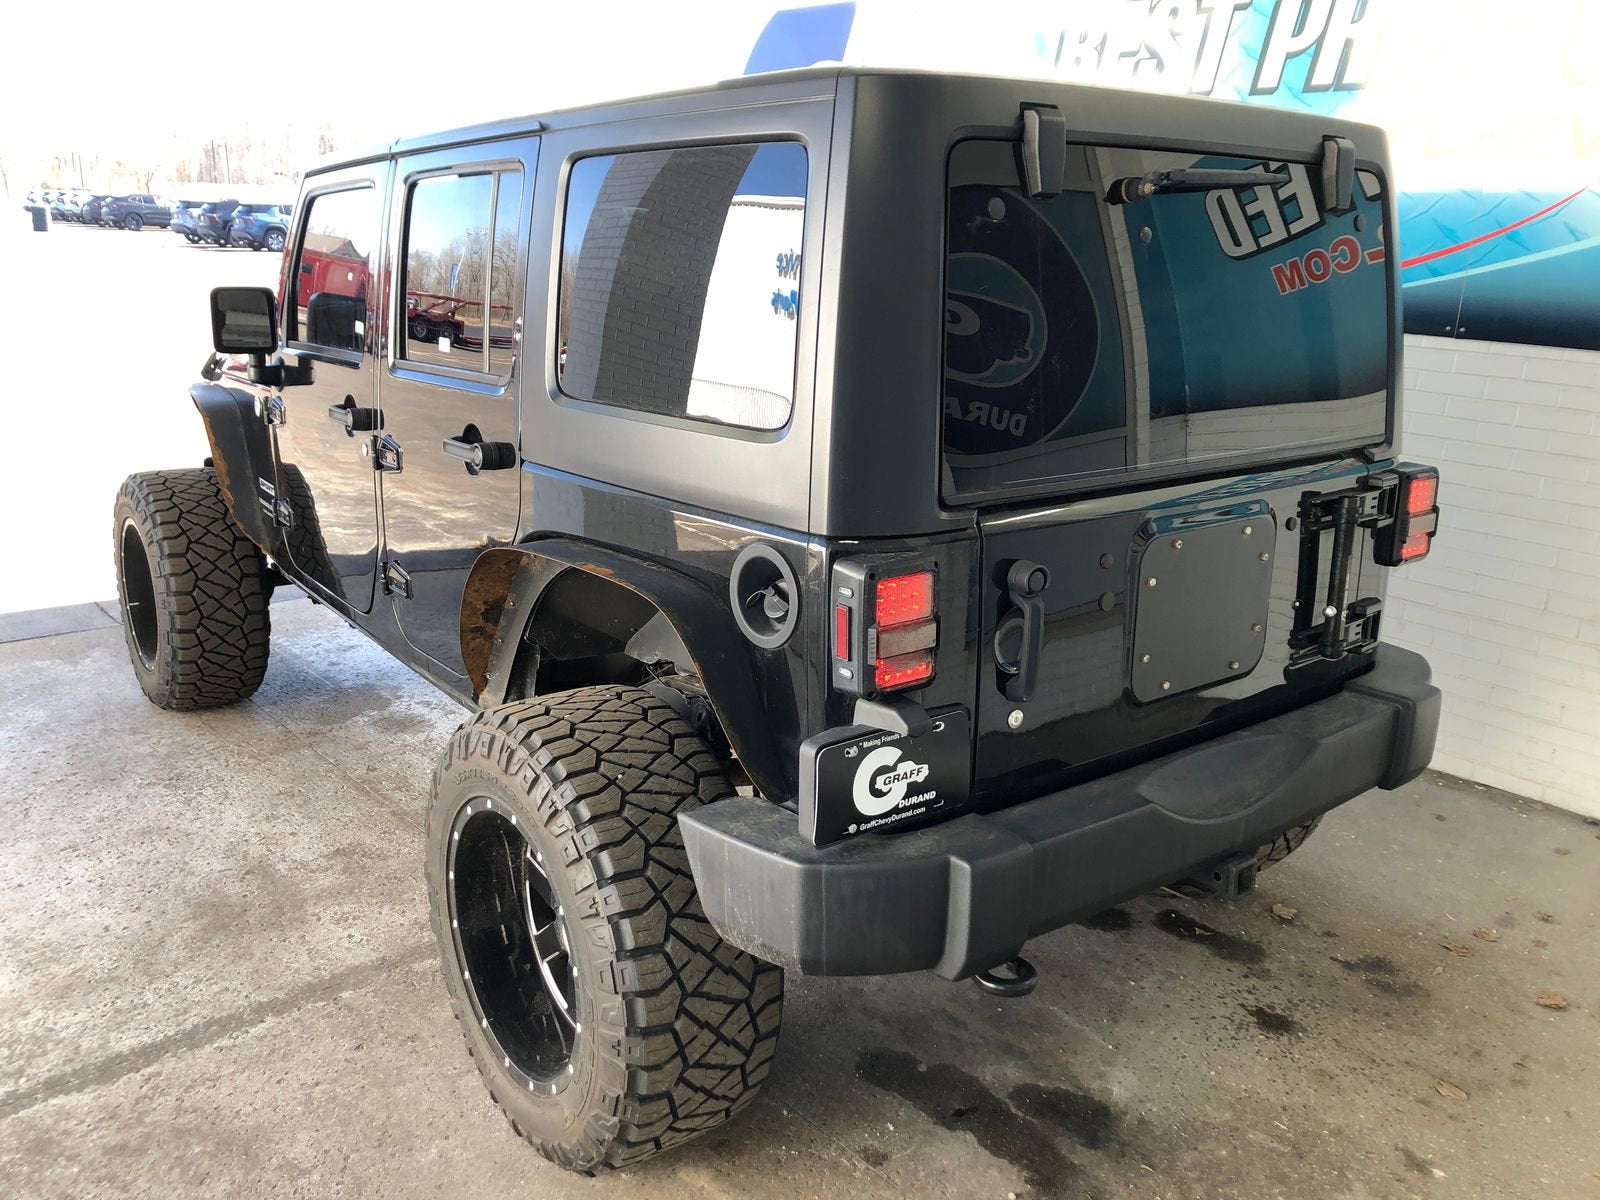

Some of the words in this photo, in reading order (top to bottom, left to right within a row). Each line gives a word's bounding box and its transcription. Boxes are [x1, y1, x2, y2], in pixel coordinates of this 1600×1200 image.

[883, 766, 923, 786] GRAFF
[898, 790, 936, 808] DURAND
[859, 806, 926, 831] GraffChevyDurand.com
